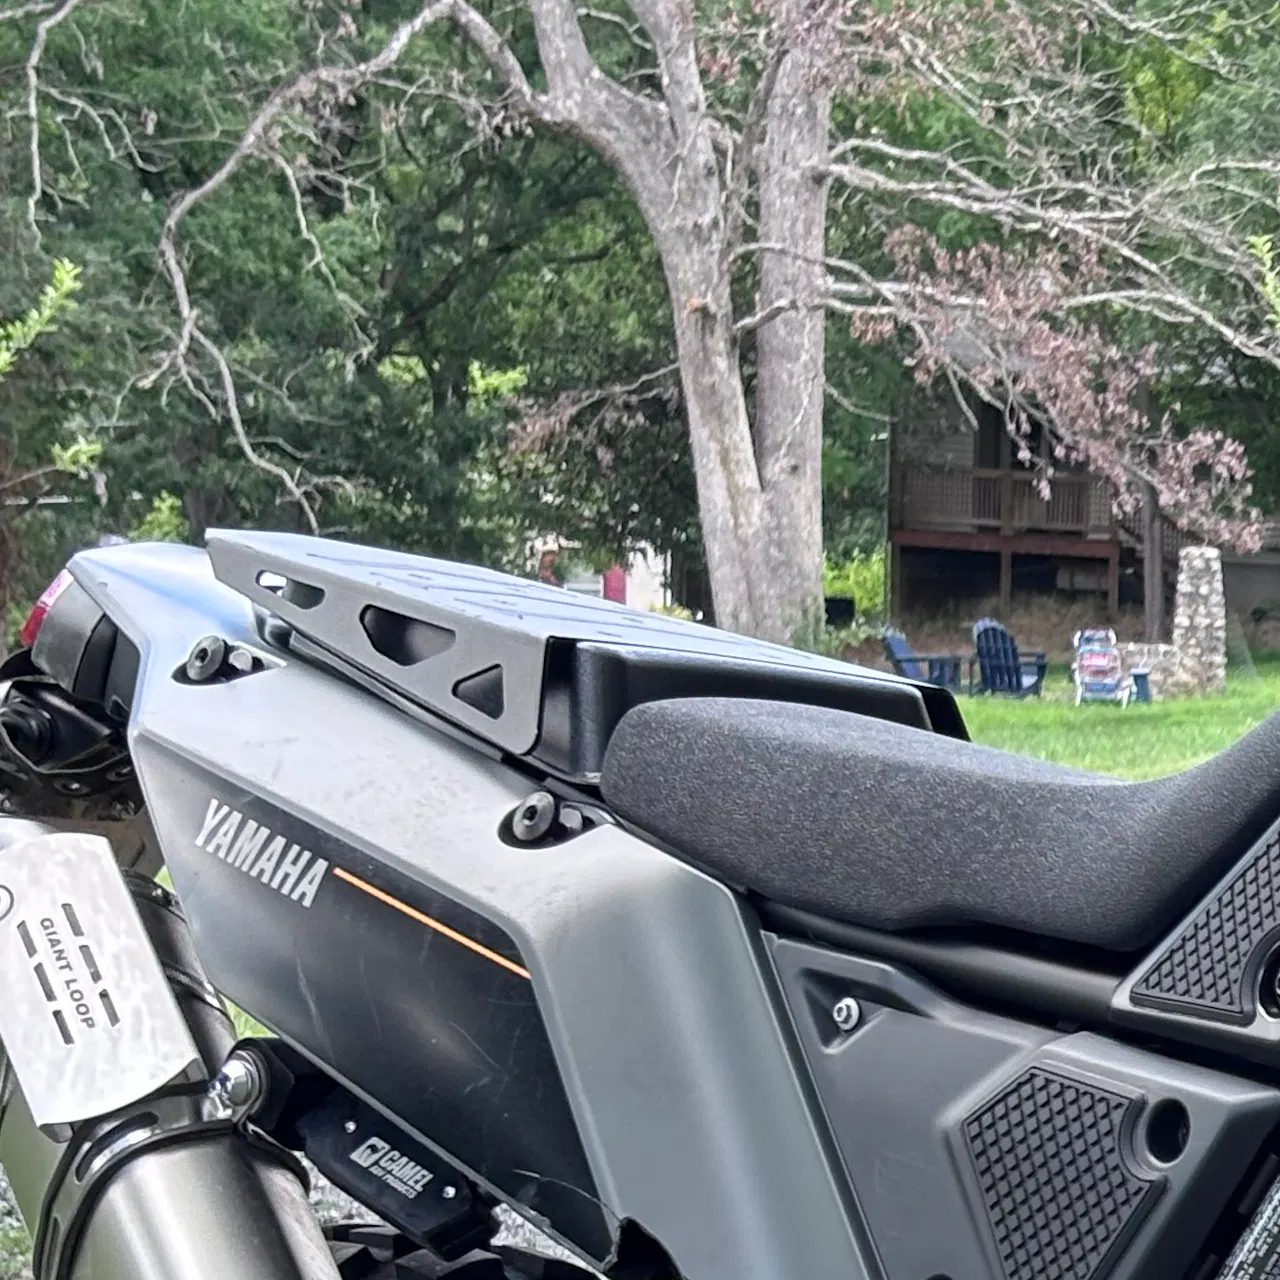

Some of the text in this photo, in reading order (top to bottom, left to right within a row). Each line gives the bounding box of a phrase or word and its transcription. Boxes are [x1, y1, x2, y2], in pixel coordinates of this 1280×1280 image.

[194, 798, 330, 909] YAMAHA
[40, 917, 96, 1029] GIANT LOOP
[378, 1150, 435, 1193] CAMEL
